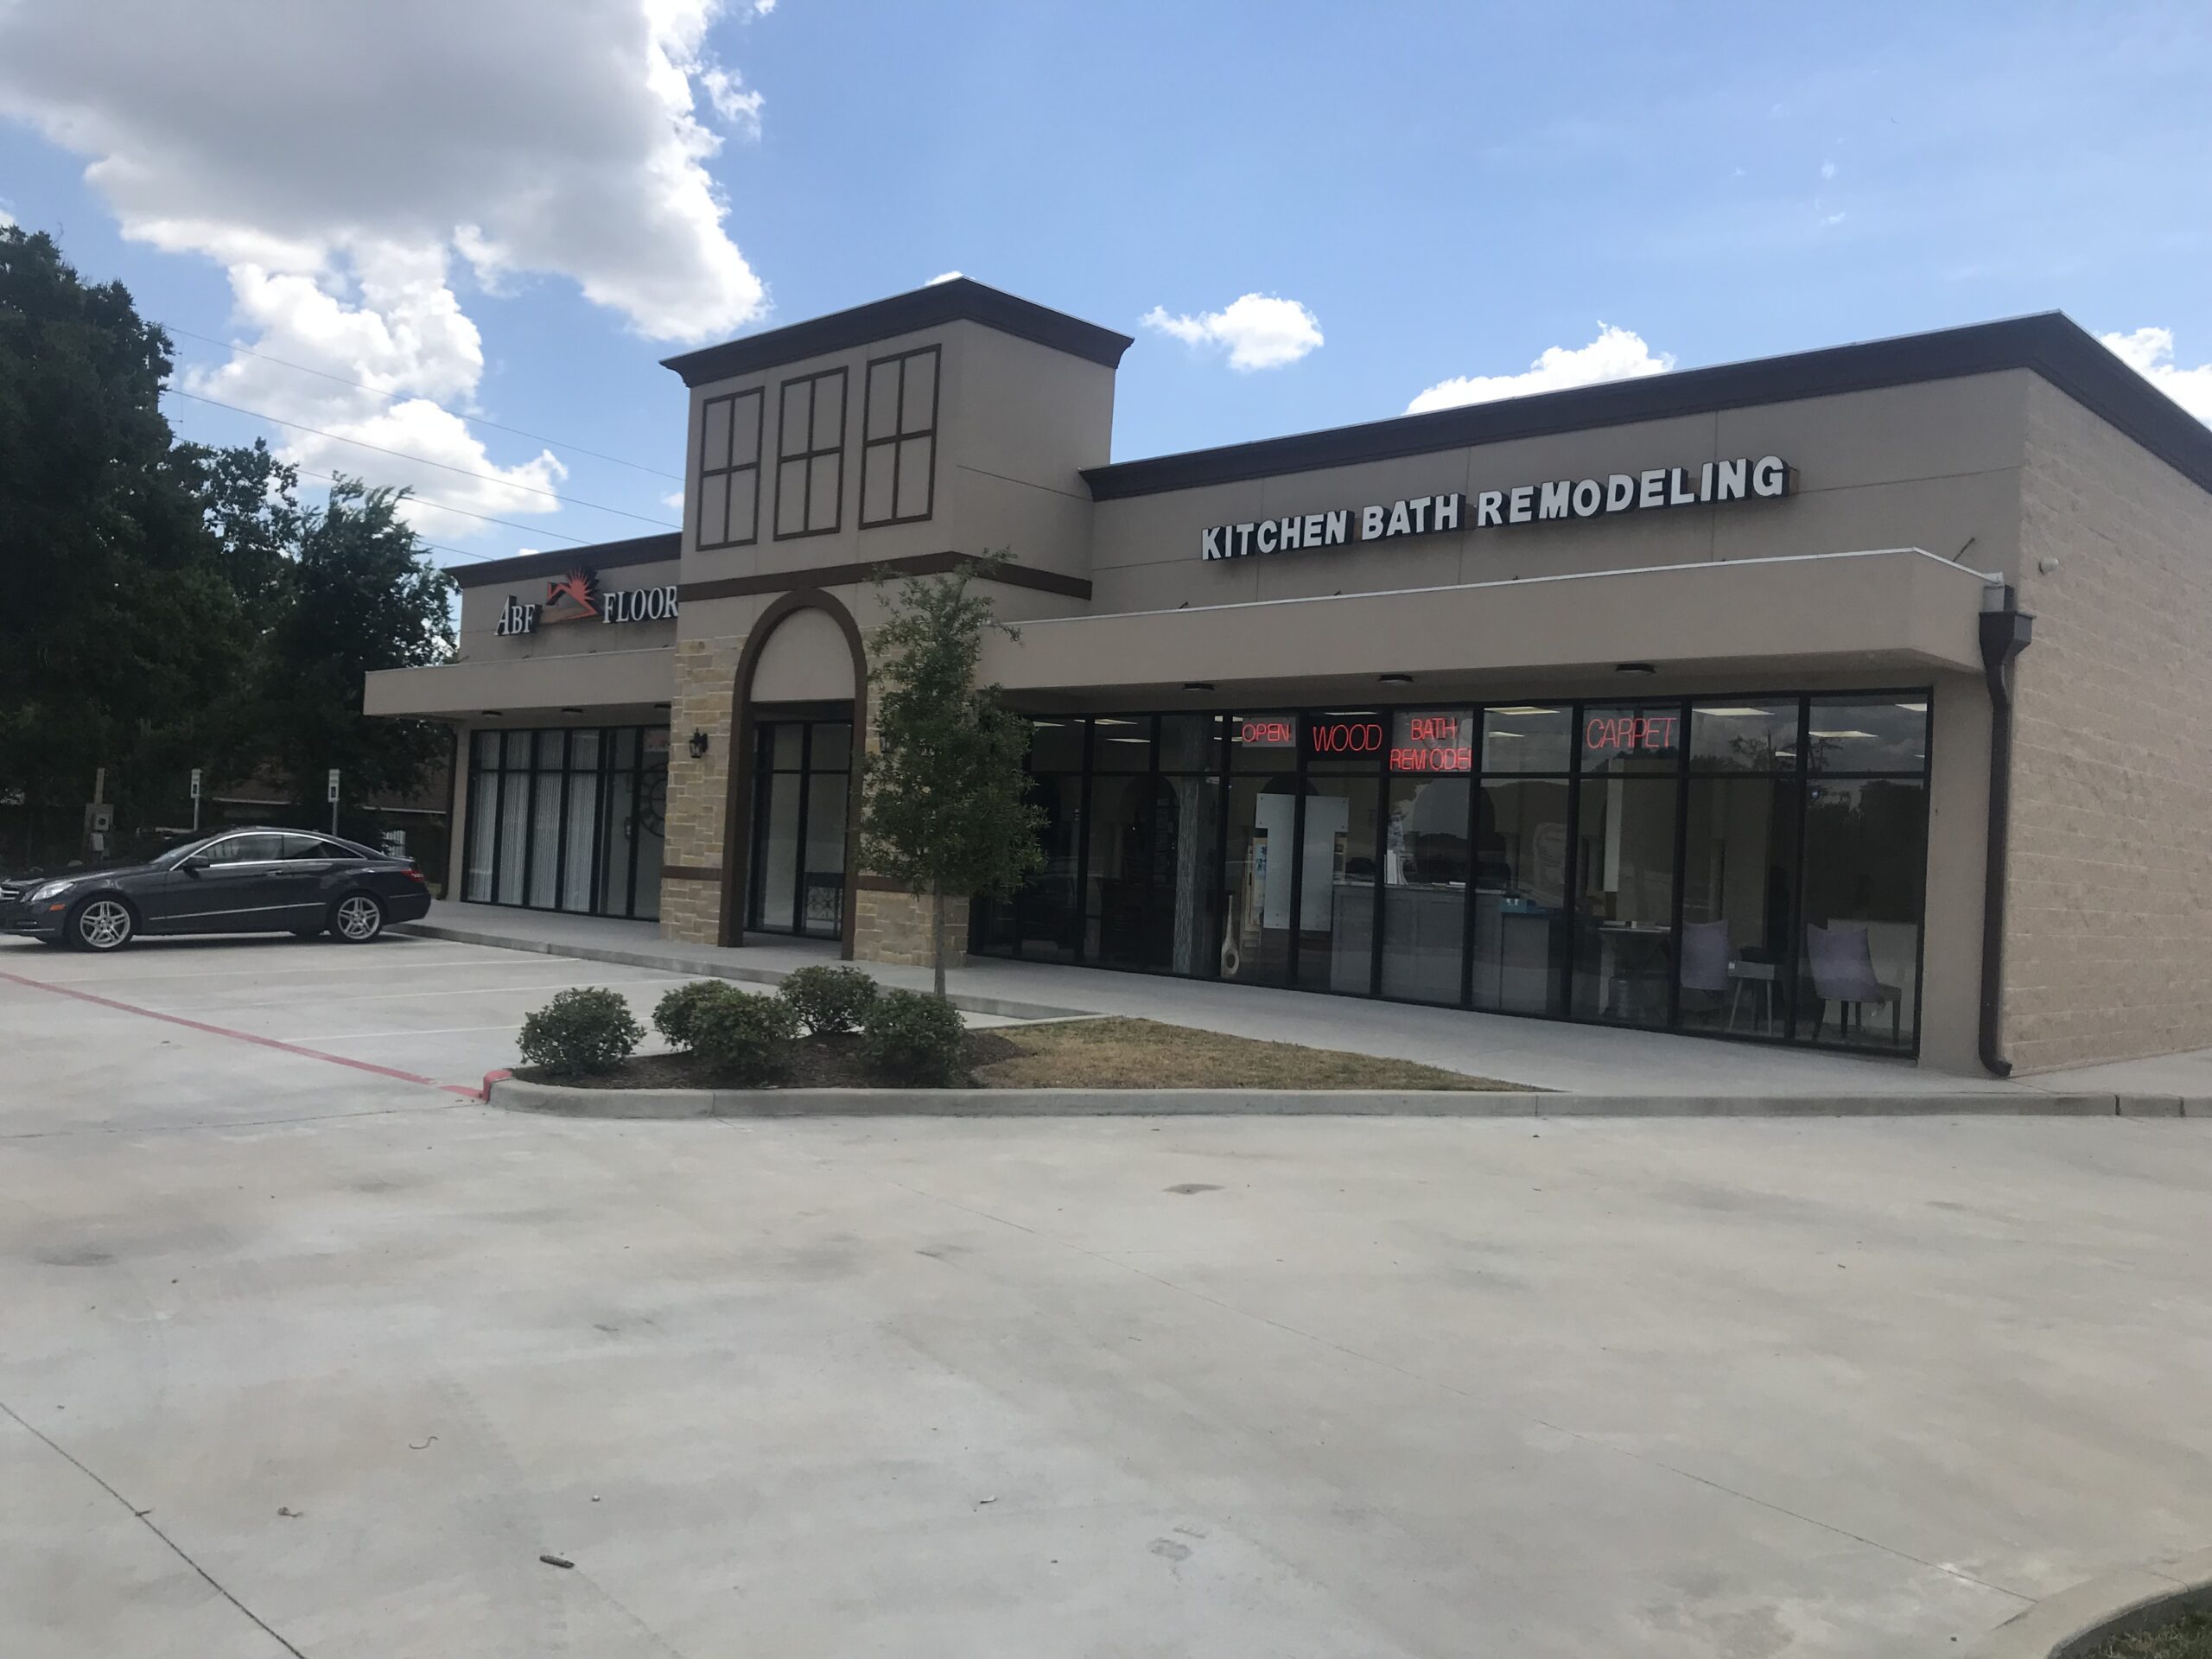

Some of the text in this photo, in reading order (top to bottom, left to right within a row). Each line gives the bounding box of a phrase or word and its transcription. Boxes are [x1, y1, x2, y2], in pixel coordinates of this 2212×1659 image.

[1200, 454, 1788, 561] KITCHEN BATH REMODELING
[1242, 723, 1289, 742] OPEN
[1313, 724, 1382, 752] WOOD
[1410, 717, 1457, 741] BATH
[1586, 717, 1677, 749] CARPET
